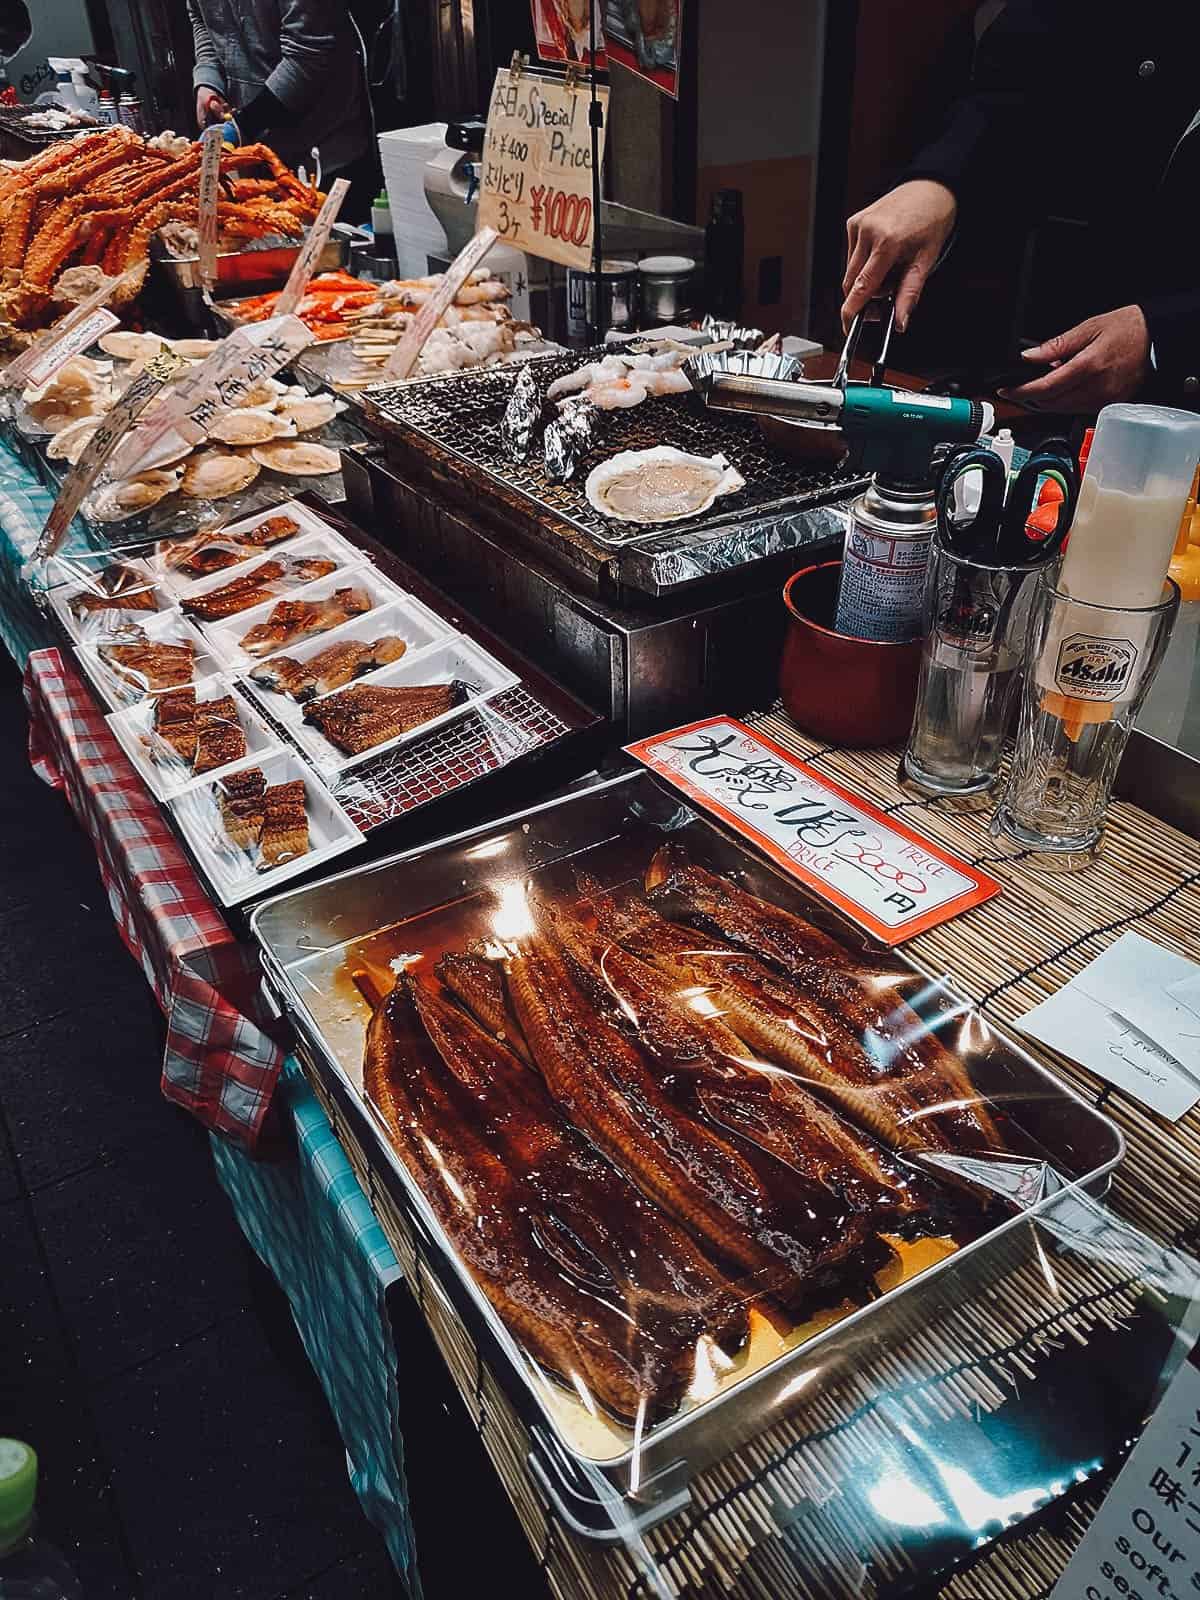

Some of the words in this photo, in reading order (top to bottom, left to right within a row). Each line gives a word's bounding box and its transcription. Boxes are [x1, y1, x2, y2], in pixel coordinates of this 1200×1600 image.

[550, 130, 593, 169] Price
[484, 162, 524, 203] よりどり
[1061, 656, 1129, 683] Asahi
[788, 840, 840, 874] PRICE
[897, 843, 947, 878] PRICE
[1131, 1508, 1187, 1563] Our
